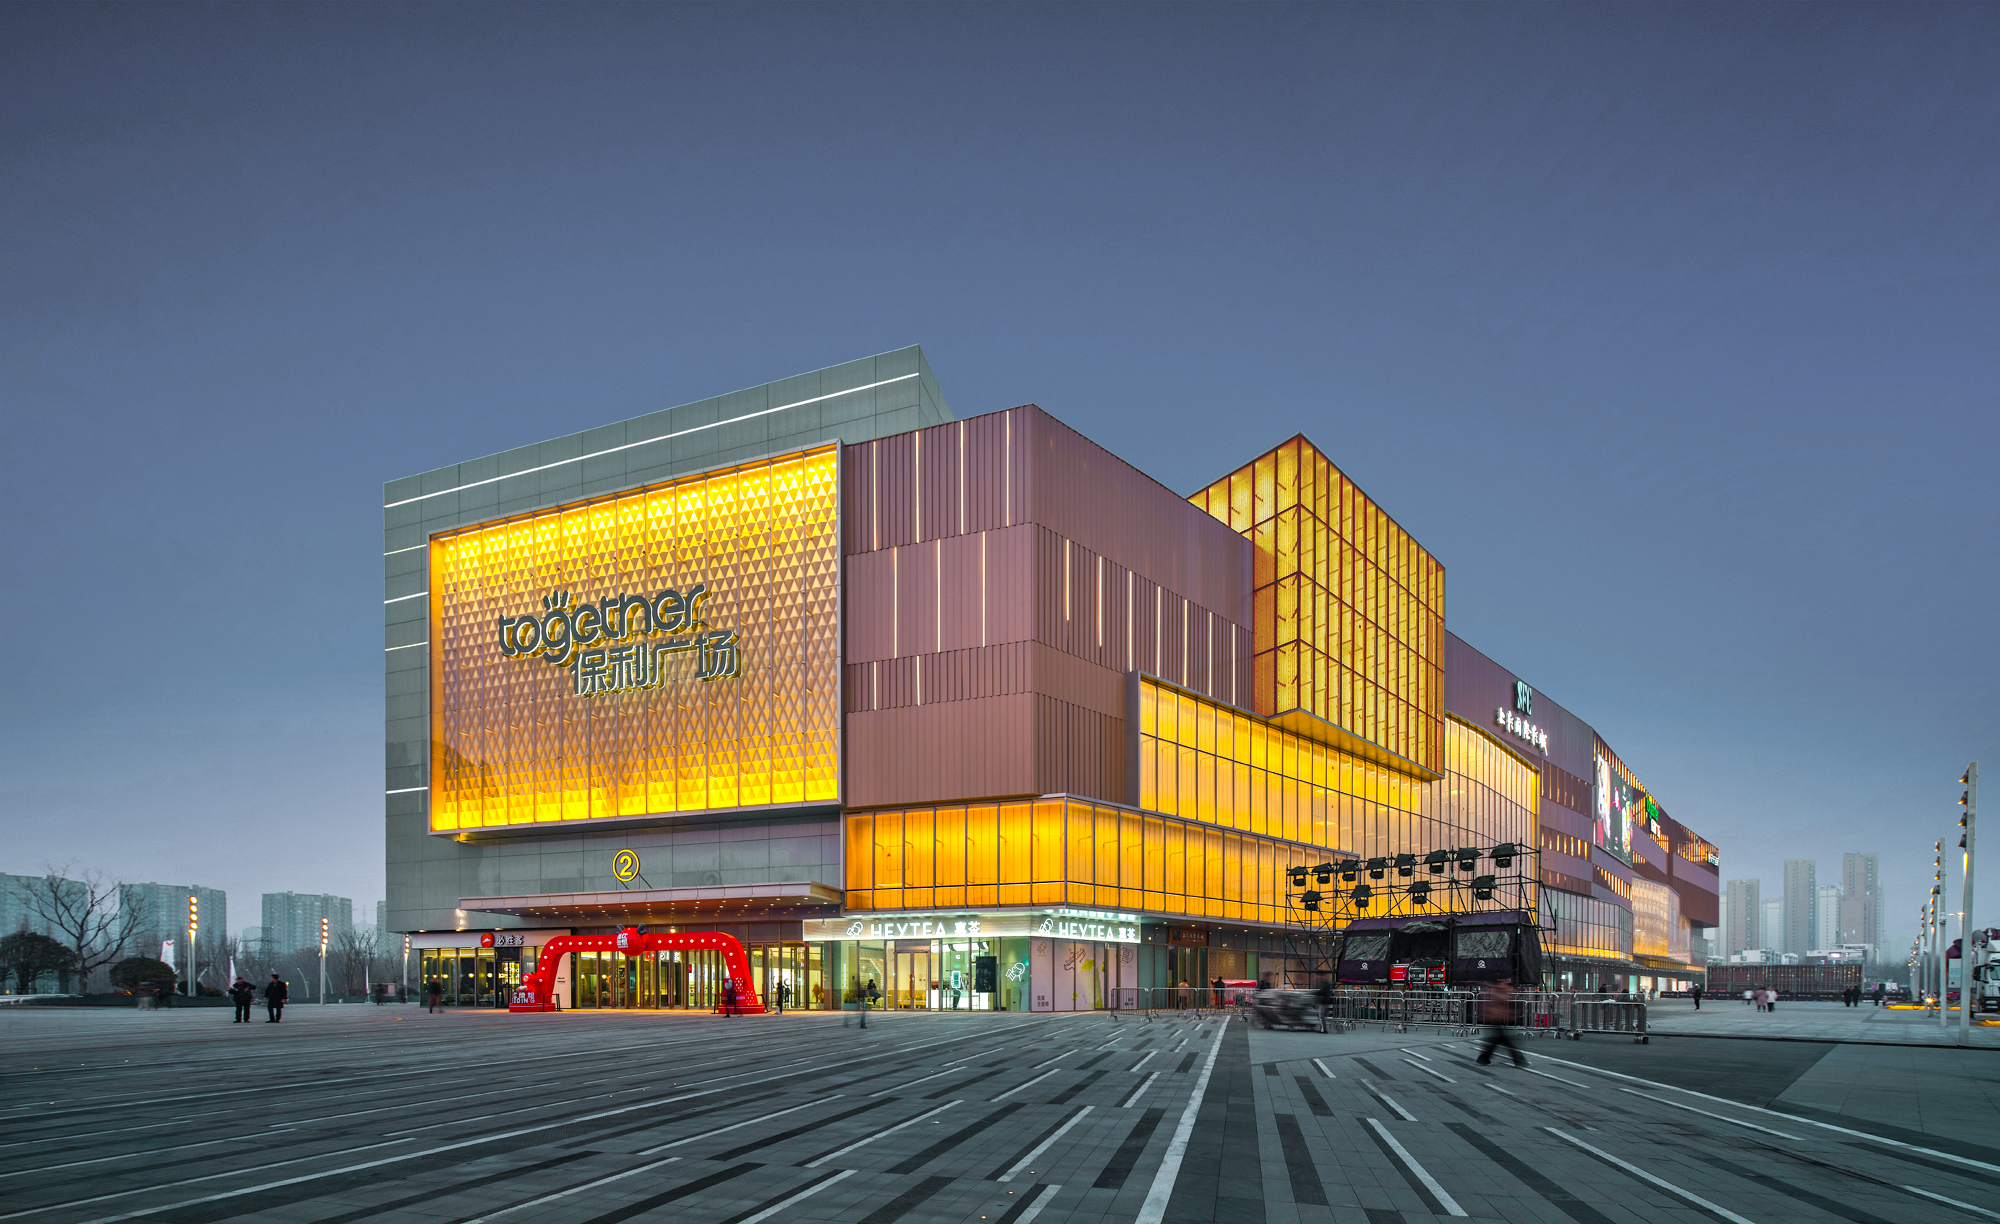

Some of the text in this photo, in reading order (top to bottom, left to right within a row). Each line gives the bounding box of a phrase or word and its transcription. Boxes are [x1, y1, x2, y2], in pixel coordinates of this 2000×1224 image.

[499, 585, 706, 664] together
[571, 630, 737, 696] 保利广场
[1517, 680, 1532, 716] SFC
[496, 935, 524, 945] 必胜客
[870, 920, 981, 938] HEYTEA 喜茶
[1059, 921, 1136, 941] HEYTEA 喜茶
